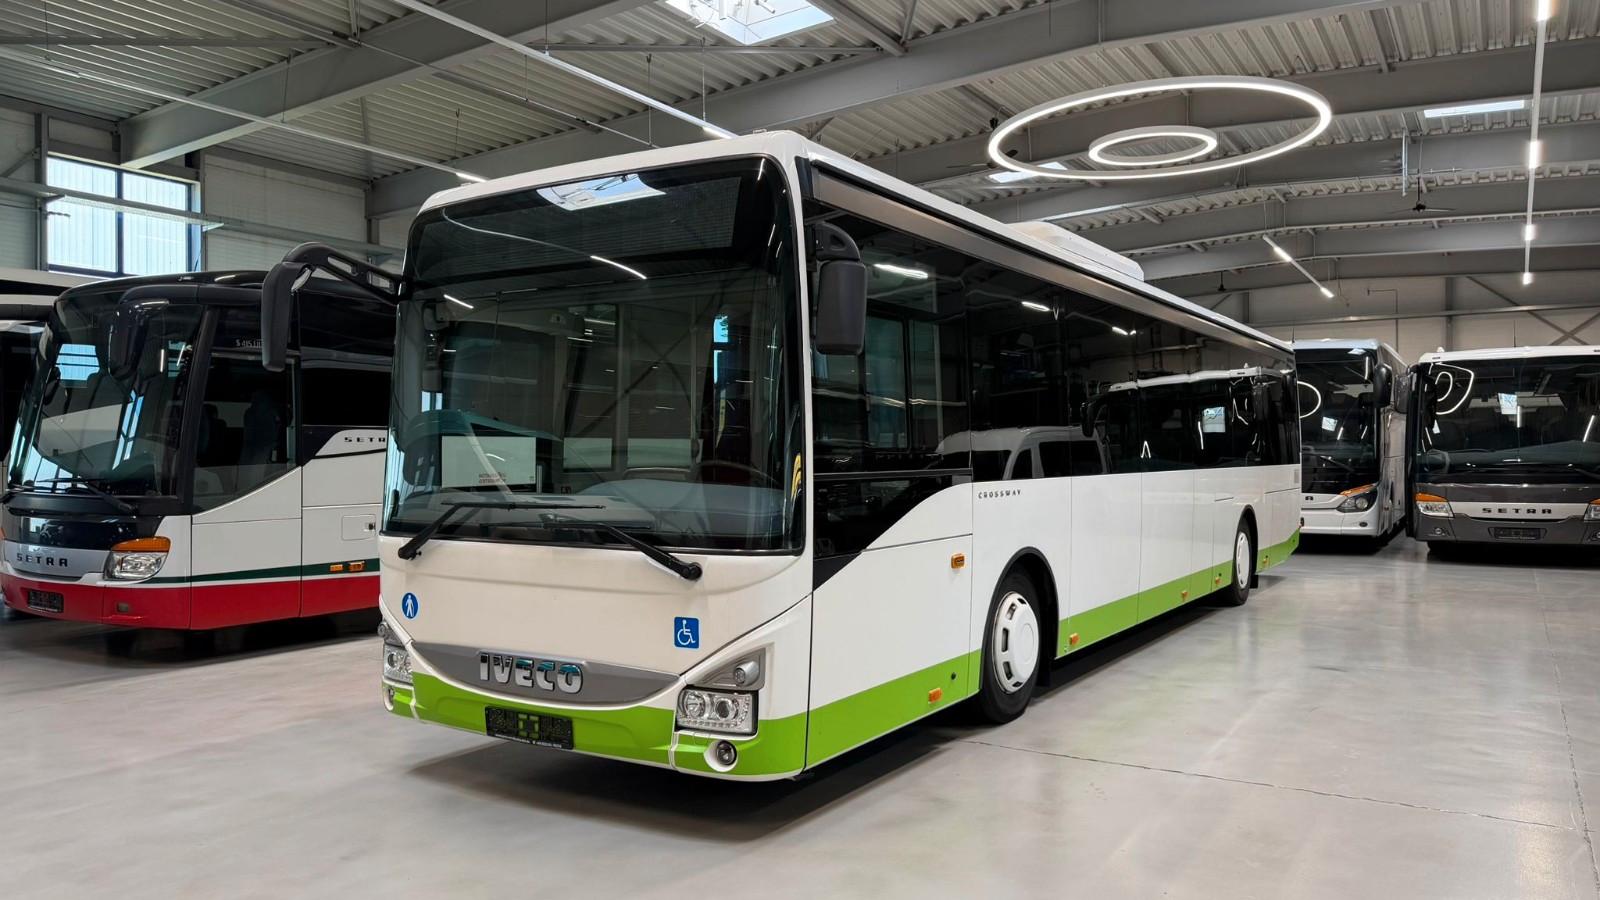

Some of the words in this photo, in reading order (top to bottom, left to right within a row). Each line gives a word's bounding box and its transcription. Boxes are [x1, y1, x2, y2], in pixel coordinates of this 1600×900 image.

[978, 489, 1021, 499] CROSSWAY
[16, 552, 68, 568] SETRA
[480, 652, 583, 694] IVECO
